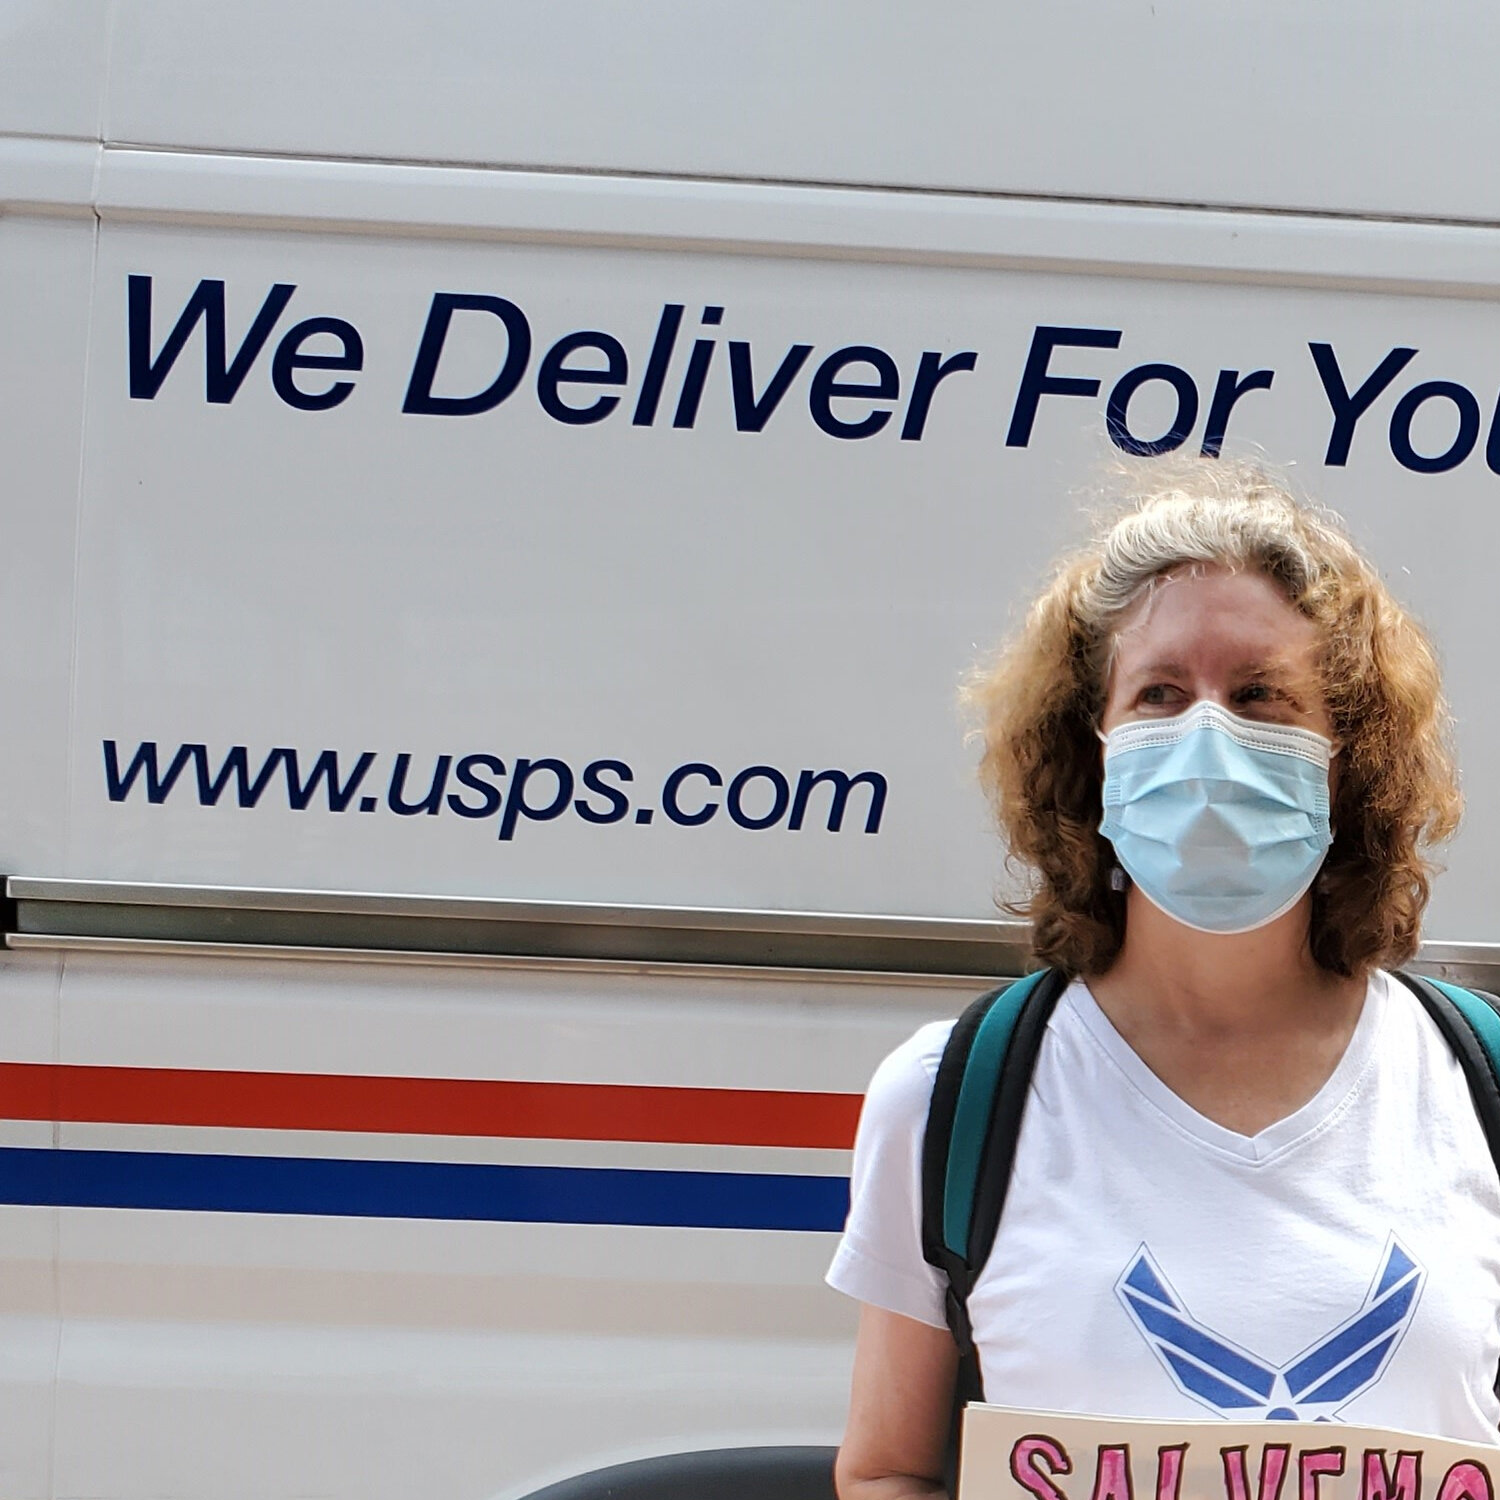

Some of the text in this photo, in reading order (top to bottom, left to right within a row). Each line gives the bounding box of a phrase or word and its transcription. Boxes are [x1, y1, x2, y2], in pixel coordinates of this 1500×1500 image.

[128, 274, 364, 412] We
[401, 292, 979, 441] Deliver
[1005, 325, 1275, 459] For
[102, 739, 888, 842] www.usps.com
